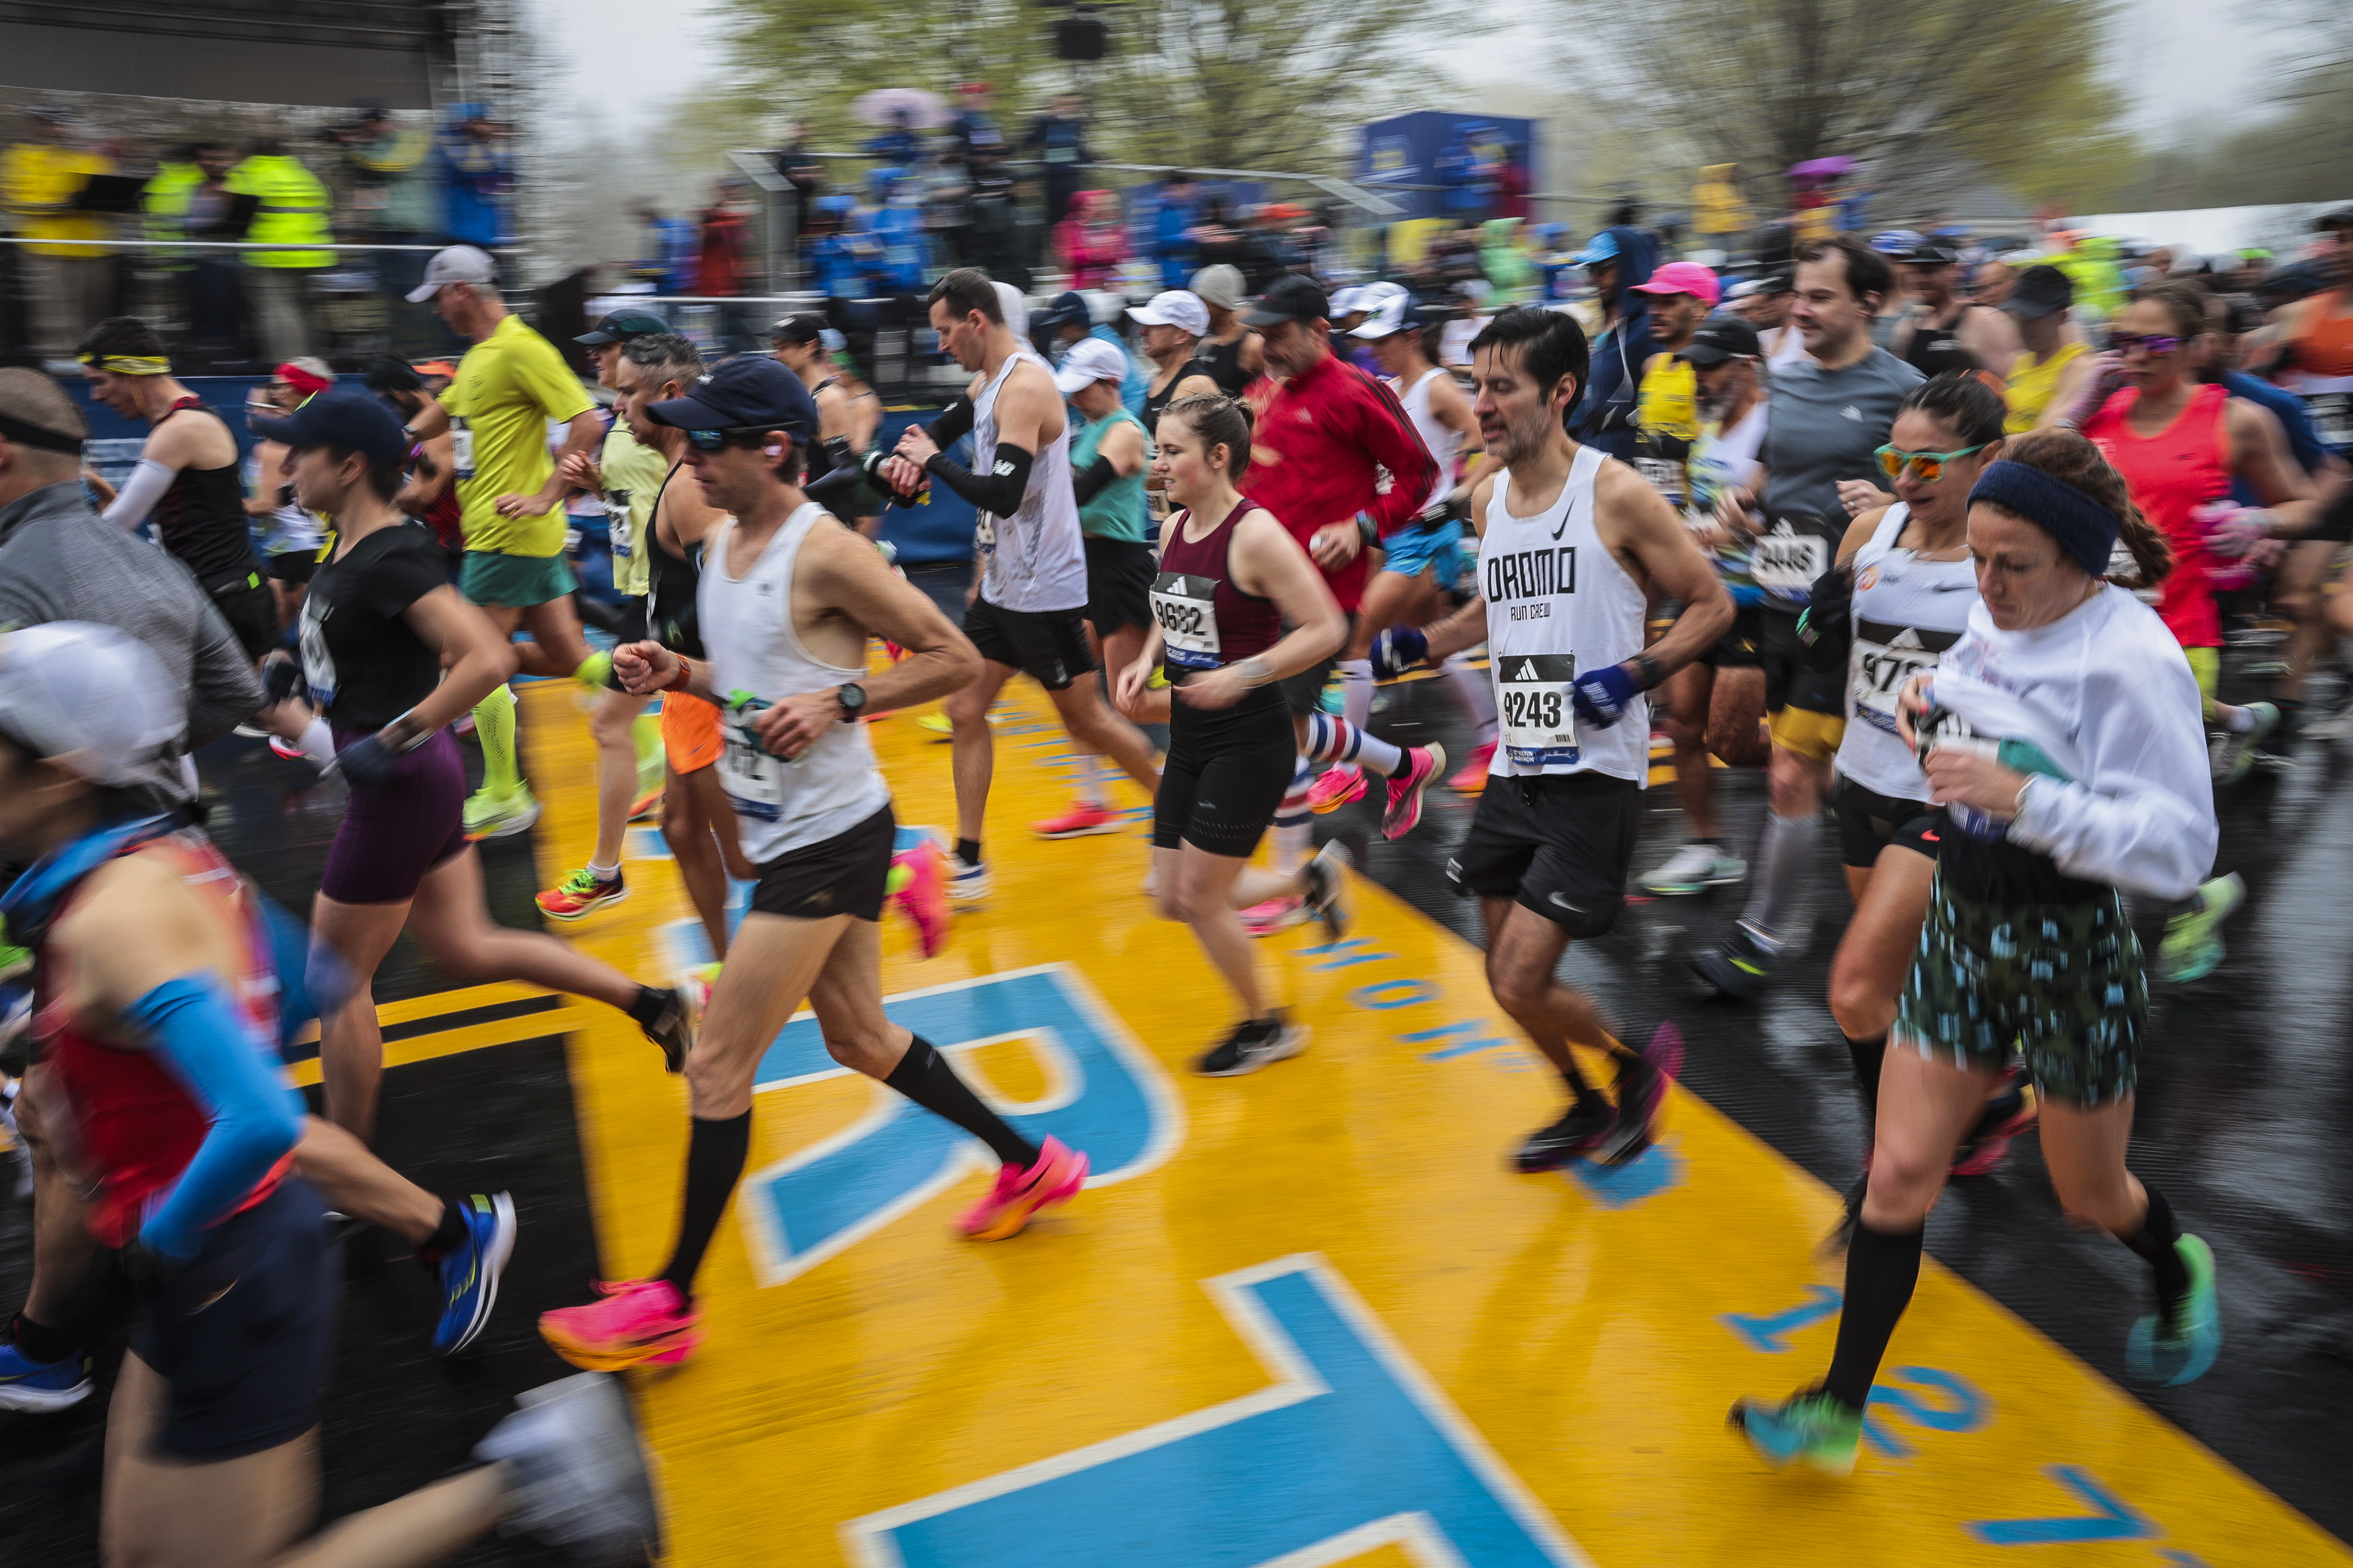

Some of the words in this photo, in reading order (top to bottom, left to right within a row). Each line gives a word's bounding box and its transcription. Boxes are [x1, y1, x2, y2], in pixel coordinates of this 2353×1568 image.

[1488, 546, 1577, 603] DROMO
[1511, 606, 1527, 622] RUN
[1530, 602, 1552, 620] CREW
[1504, 691, 1562, 729] 9243
